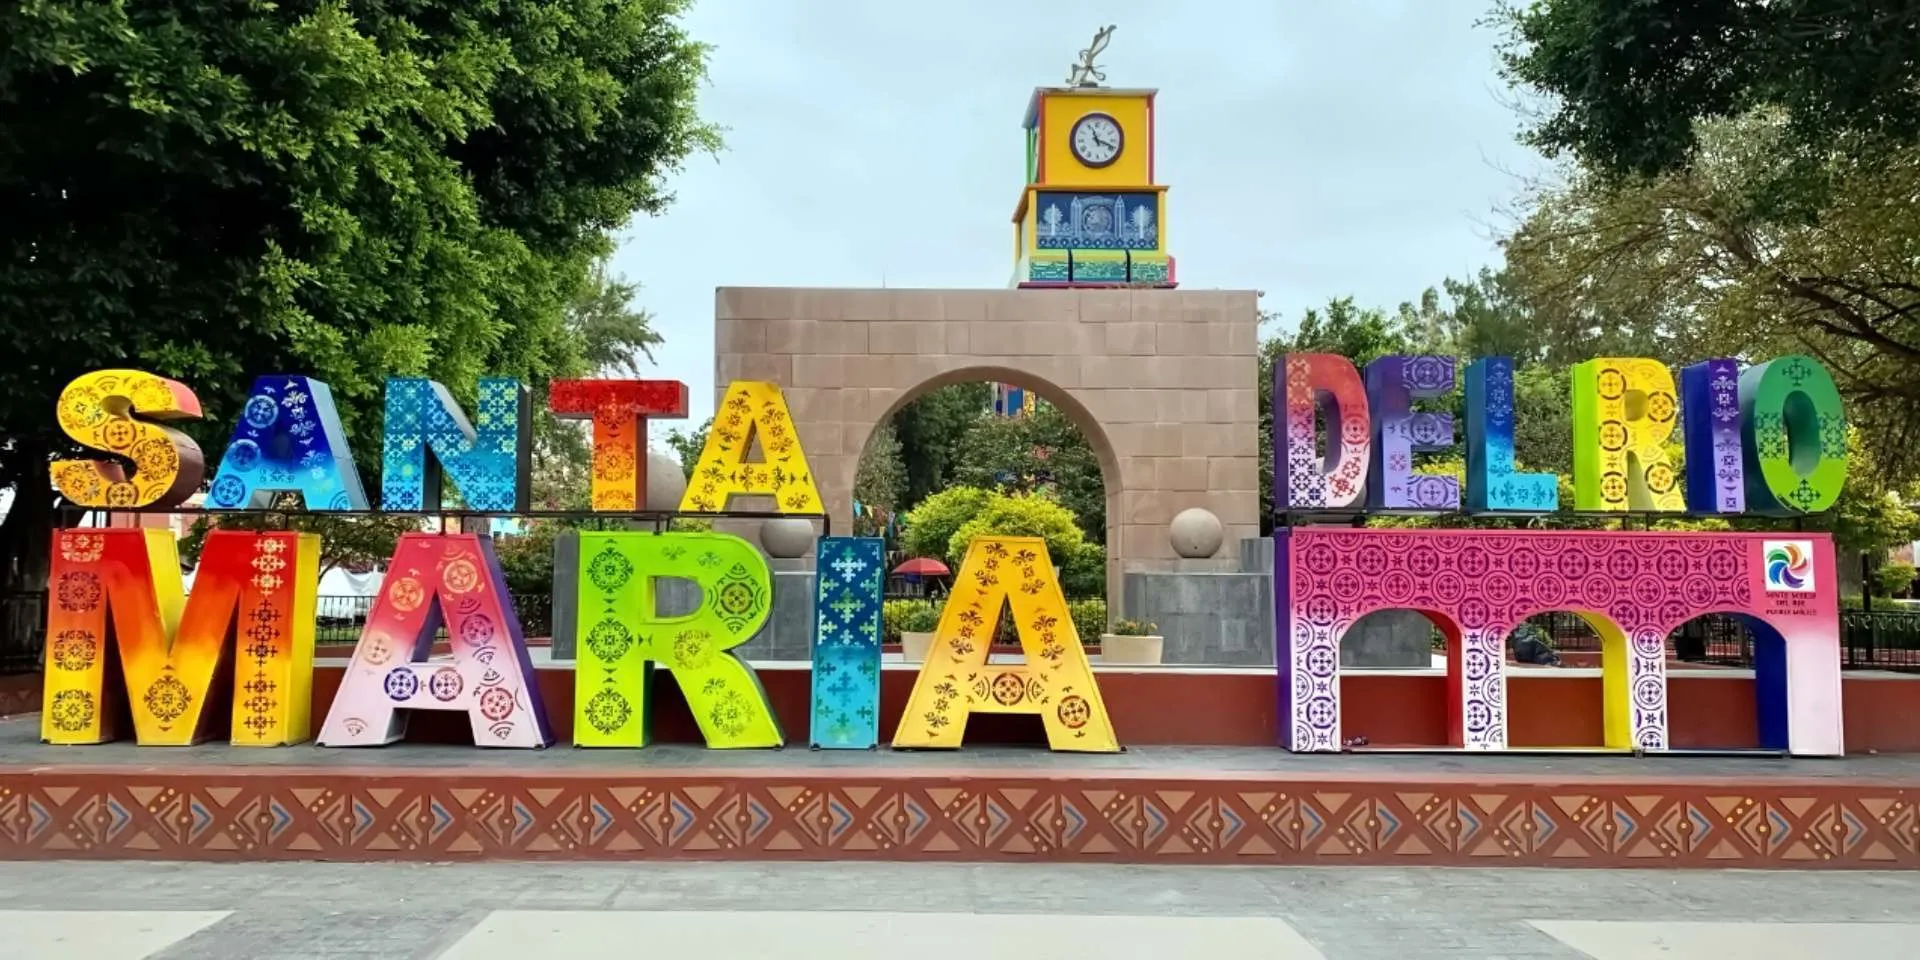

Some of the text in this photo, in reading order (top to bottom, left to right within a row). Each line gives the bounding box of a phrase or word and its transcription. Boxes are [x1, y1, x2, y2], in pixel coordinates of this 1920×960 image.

[50, 369, 825, 512] SANTA
[1274, 352, 1847, 514] DEL RIO
[41, 528, 1124, 754] MARIA
